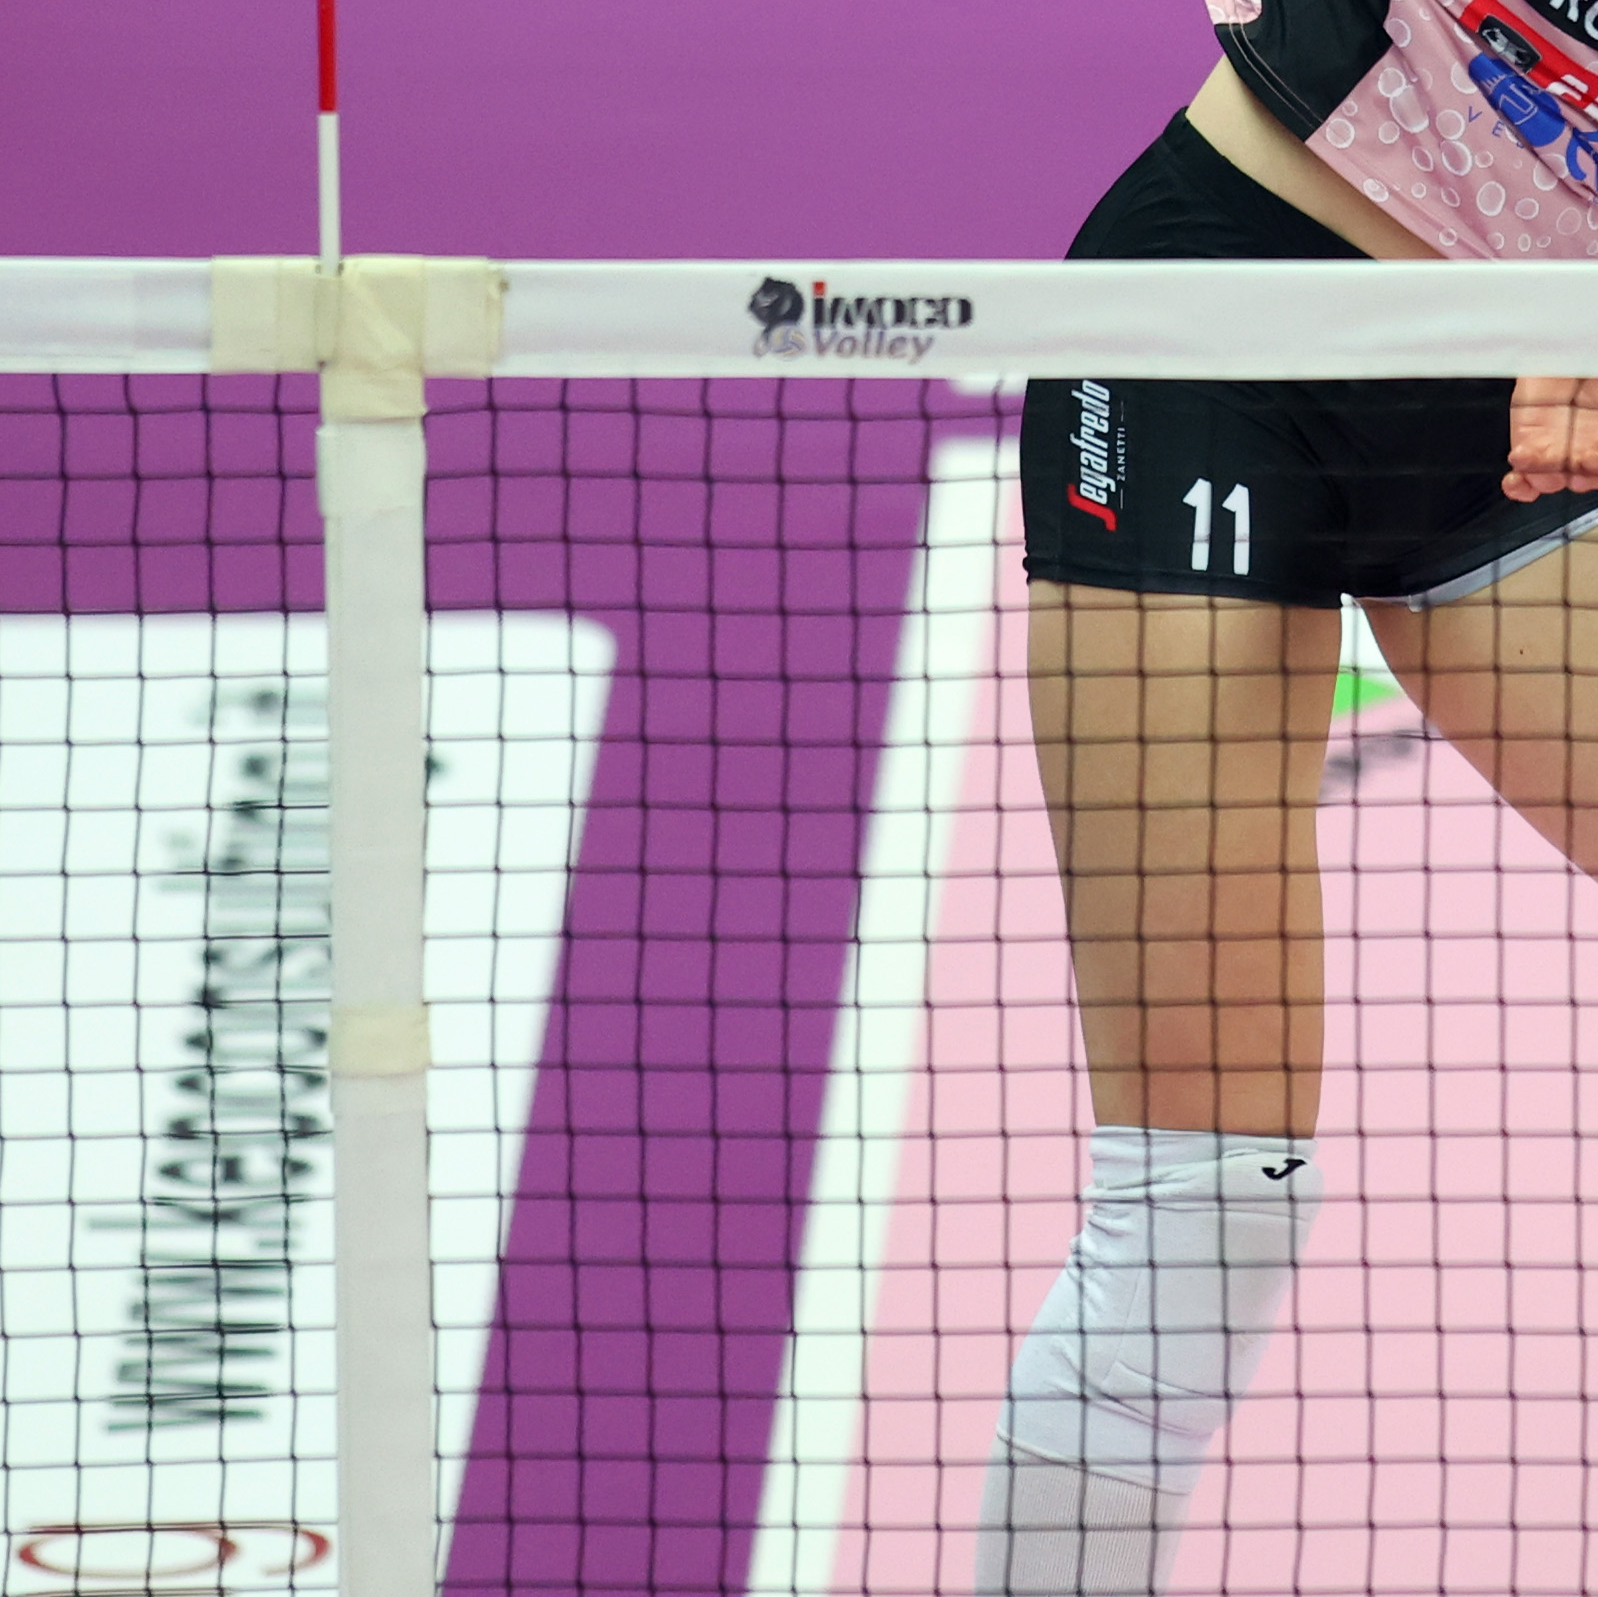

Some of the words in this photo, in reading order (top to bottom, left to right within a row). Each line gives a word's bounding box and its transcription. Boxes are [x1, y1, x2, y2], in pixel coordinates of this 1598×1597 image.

[813, 330, 935, 364] Volley
[1066, 380, 1117, 532] Segafredo
[1117, 428, 1126, 482] ZANETTI
[1183, 477, 1251, 576] 11
